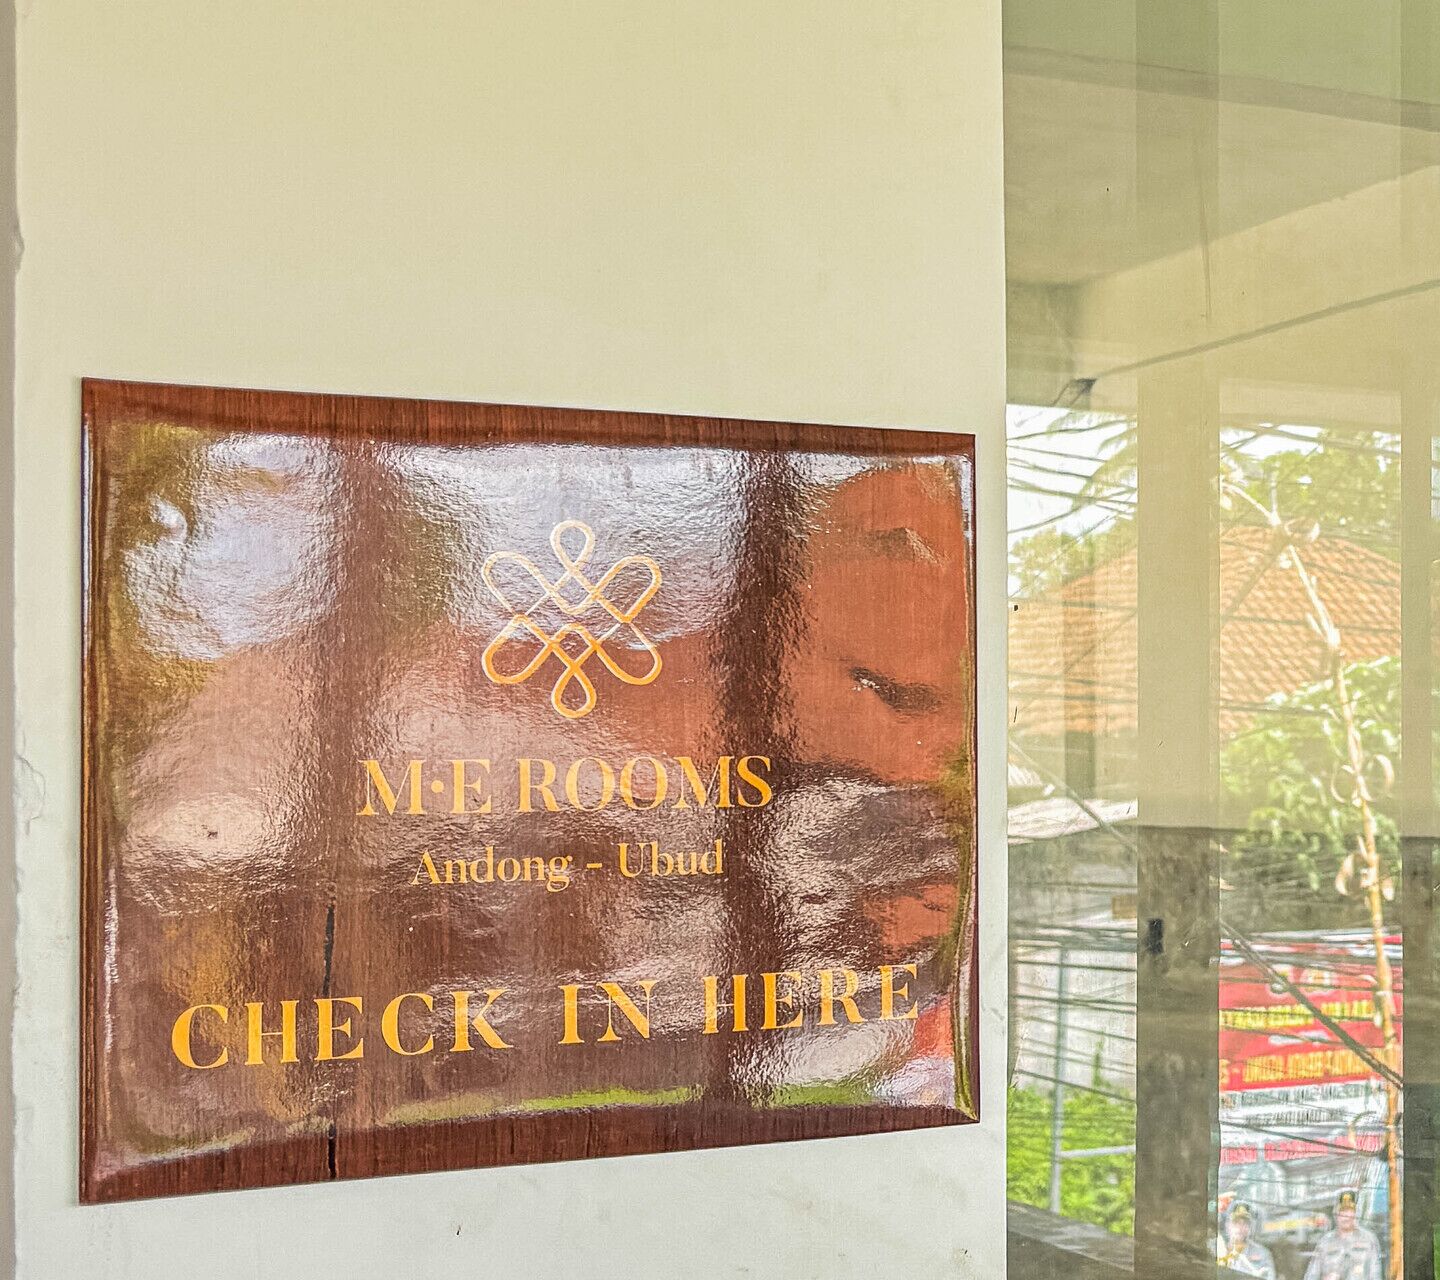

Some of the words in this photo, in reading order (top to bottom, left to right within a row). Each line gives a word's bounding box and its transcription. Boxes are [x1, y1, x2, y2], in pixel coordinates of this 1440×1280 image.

[518, 754, 775, 814] ROOMS
[409, 847, 573, 893] Andong
[618, 838, 725, 879] Ubud
[169, 987, 518, 1070] CHECK
[558, 978, 668, 1046] IN
[700, 962, 920, 1036] HERE
